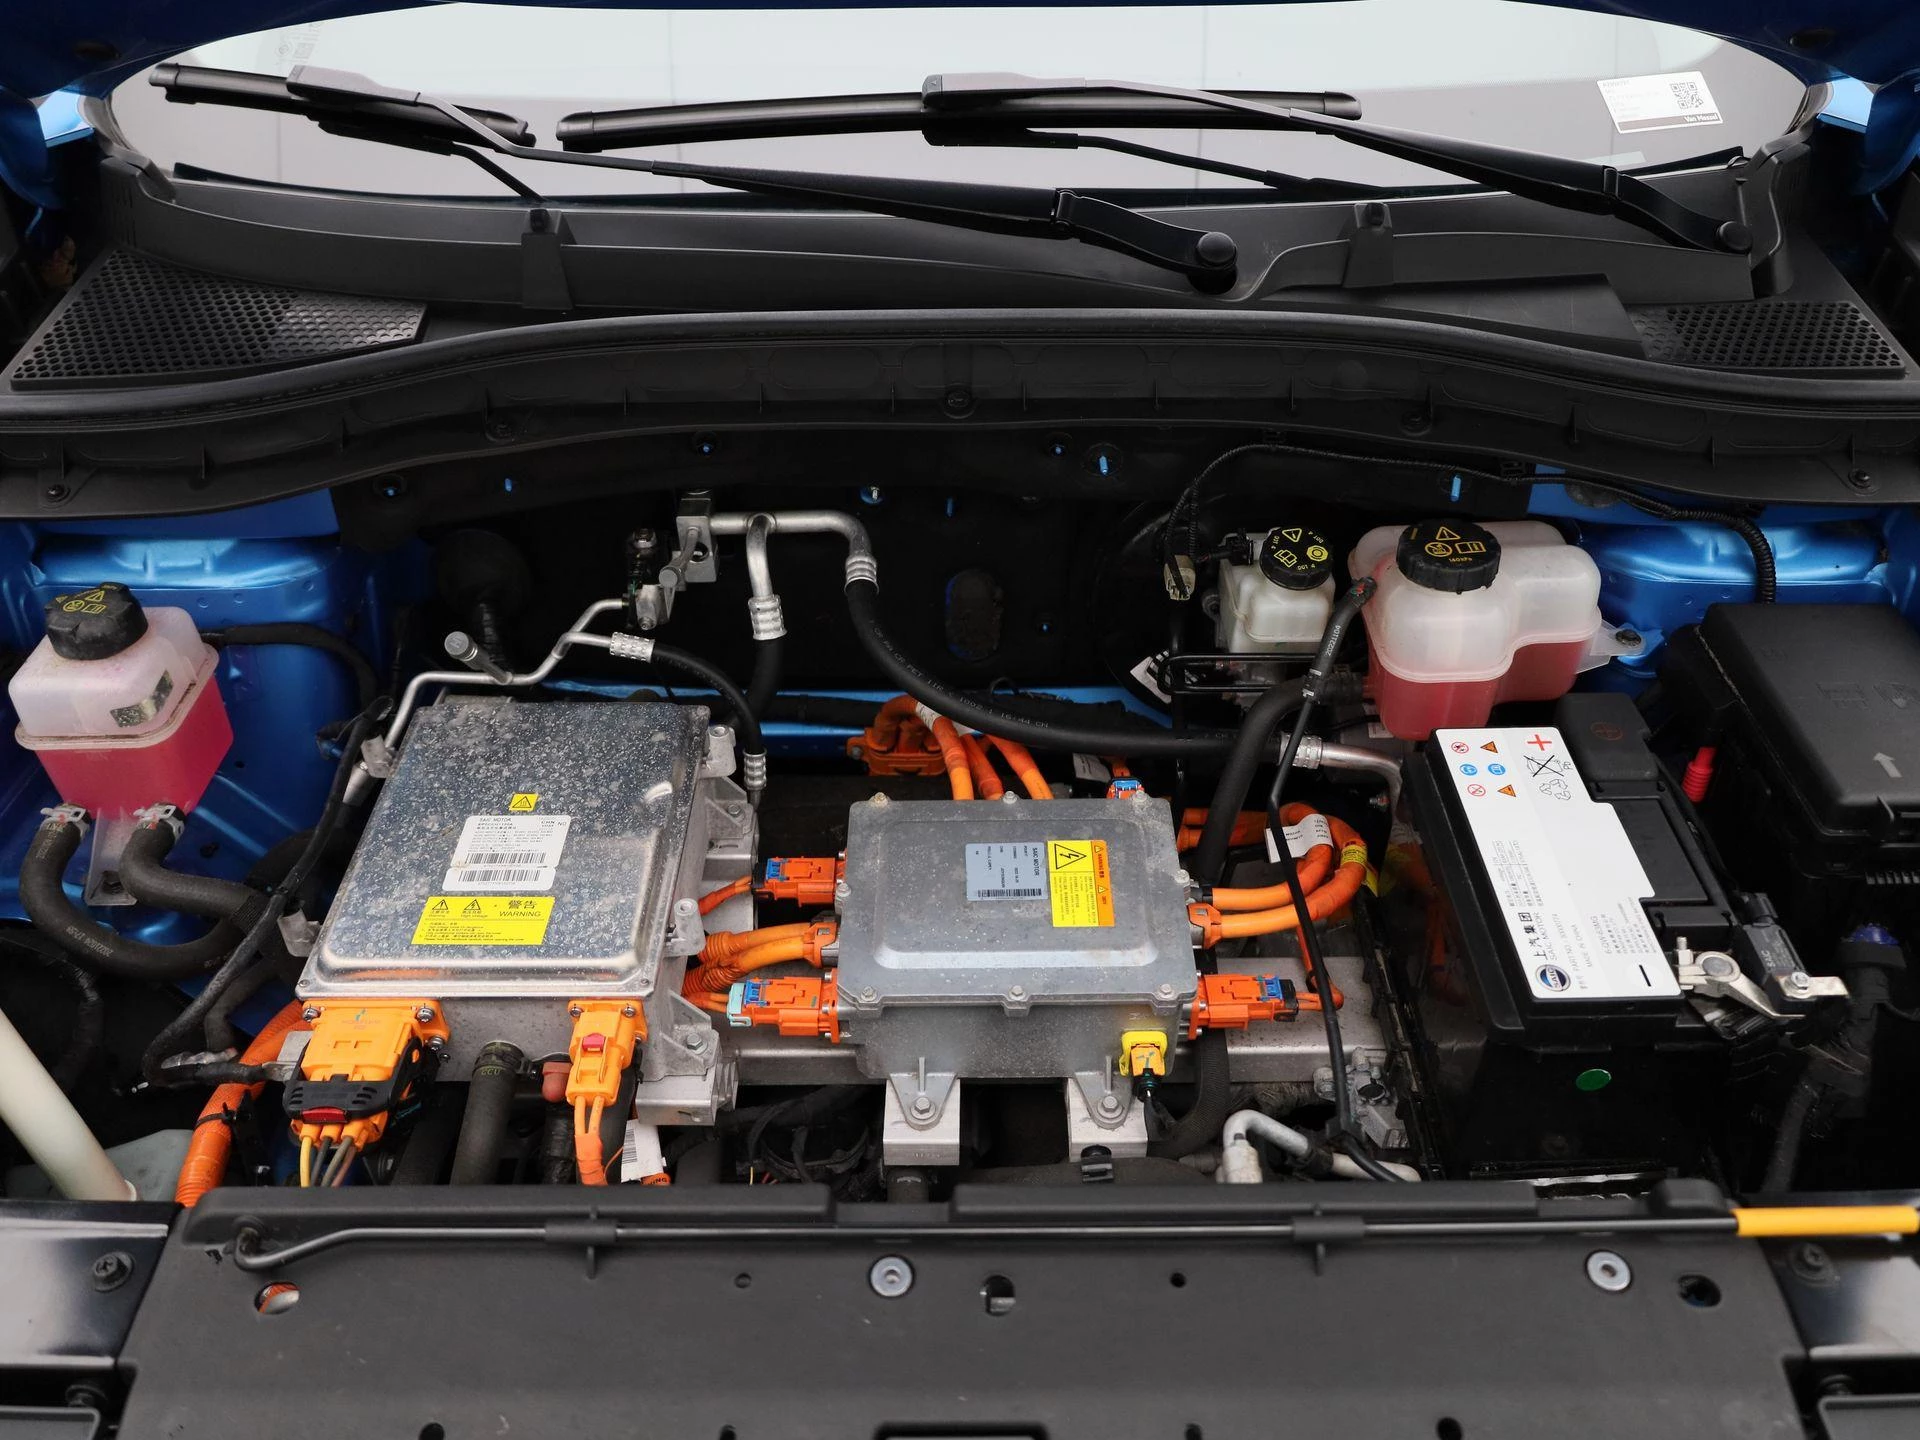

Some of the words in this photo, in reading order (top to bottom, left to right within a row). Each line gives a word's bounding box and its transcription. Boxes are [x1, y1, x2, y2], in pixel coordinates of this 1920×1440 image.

[1518, 912, 1548, 960] 上汽集团
[1548, 967, 1561, 989] SAIC
